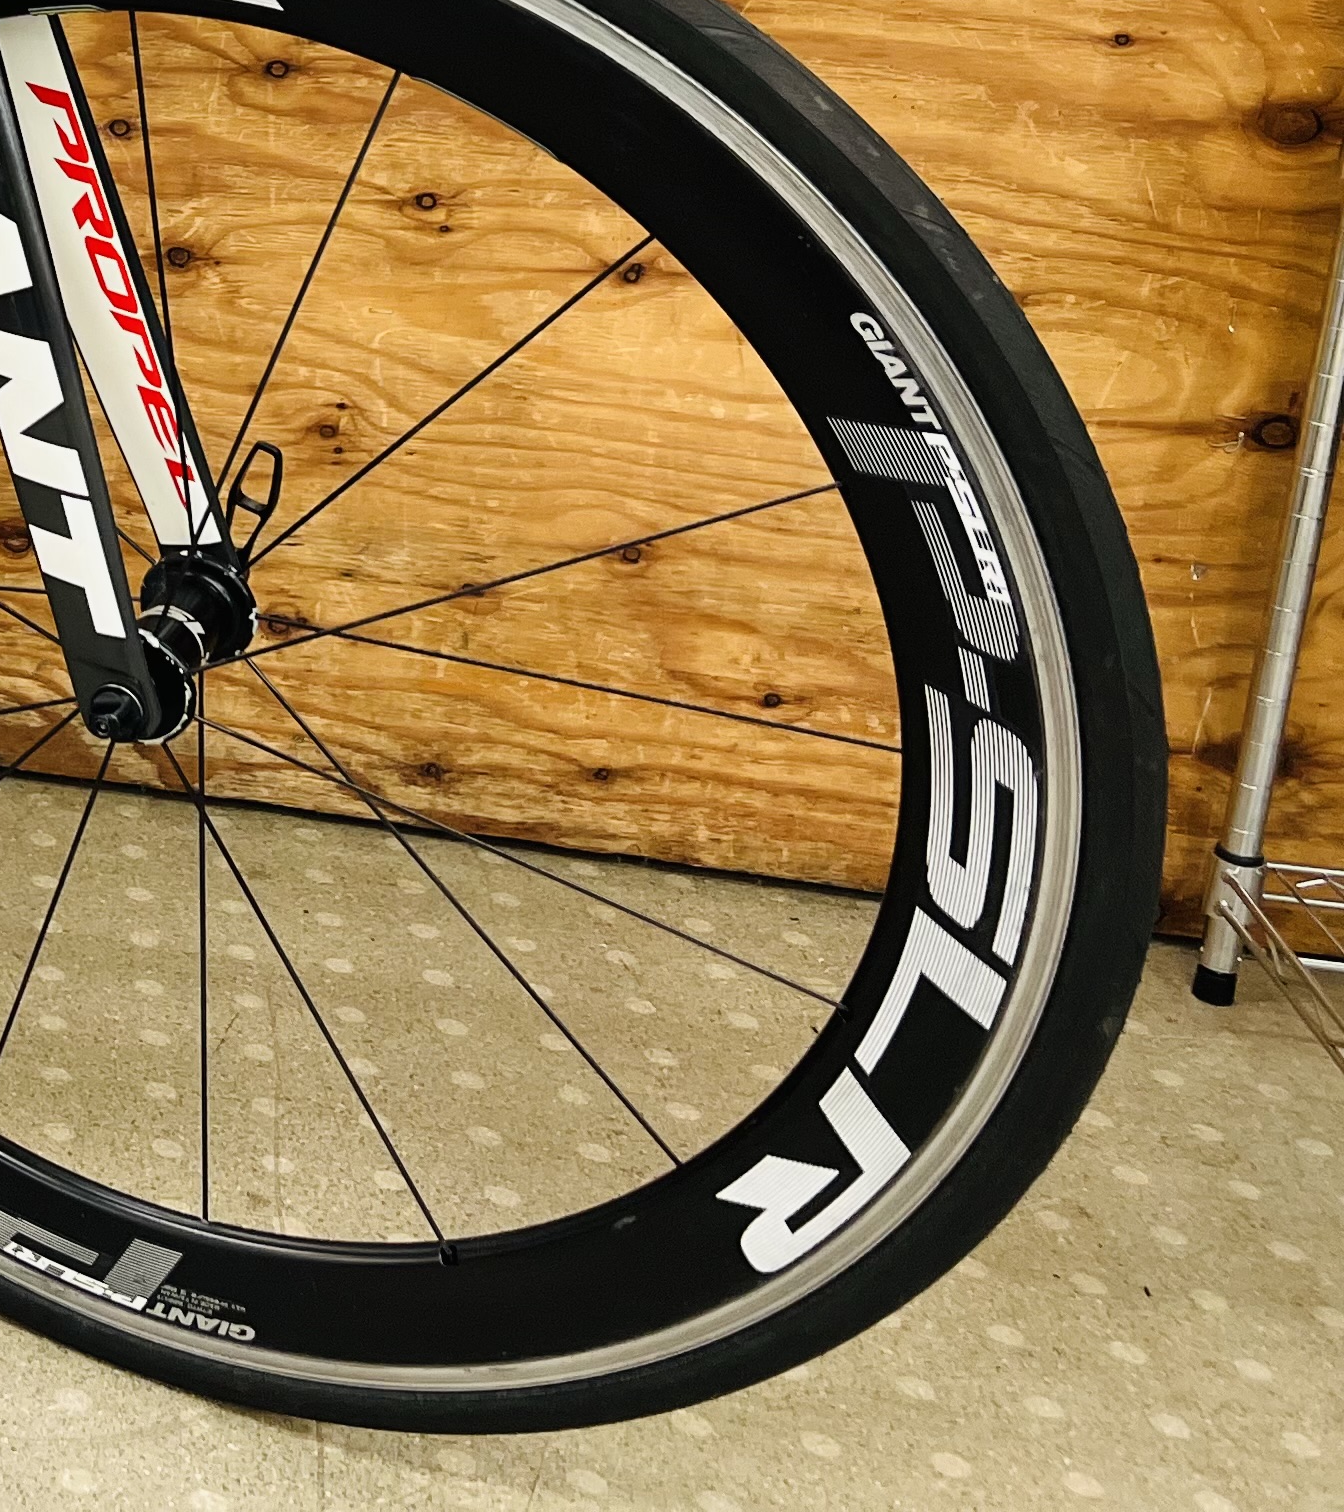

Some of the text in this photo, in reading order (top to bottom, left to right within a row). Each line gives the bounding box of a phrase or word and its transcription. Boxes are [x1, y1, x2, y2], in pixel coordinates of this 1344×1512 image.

[25, 80, 195, 509] PROPEL
[848, 310, 939, 431] GIANT
[145, 1298, 256, 1342] GIANT
